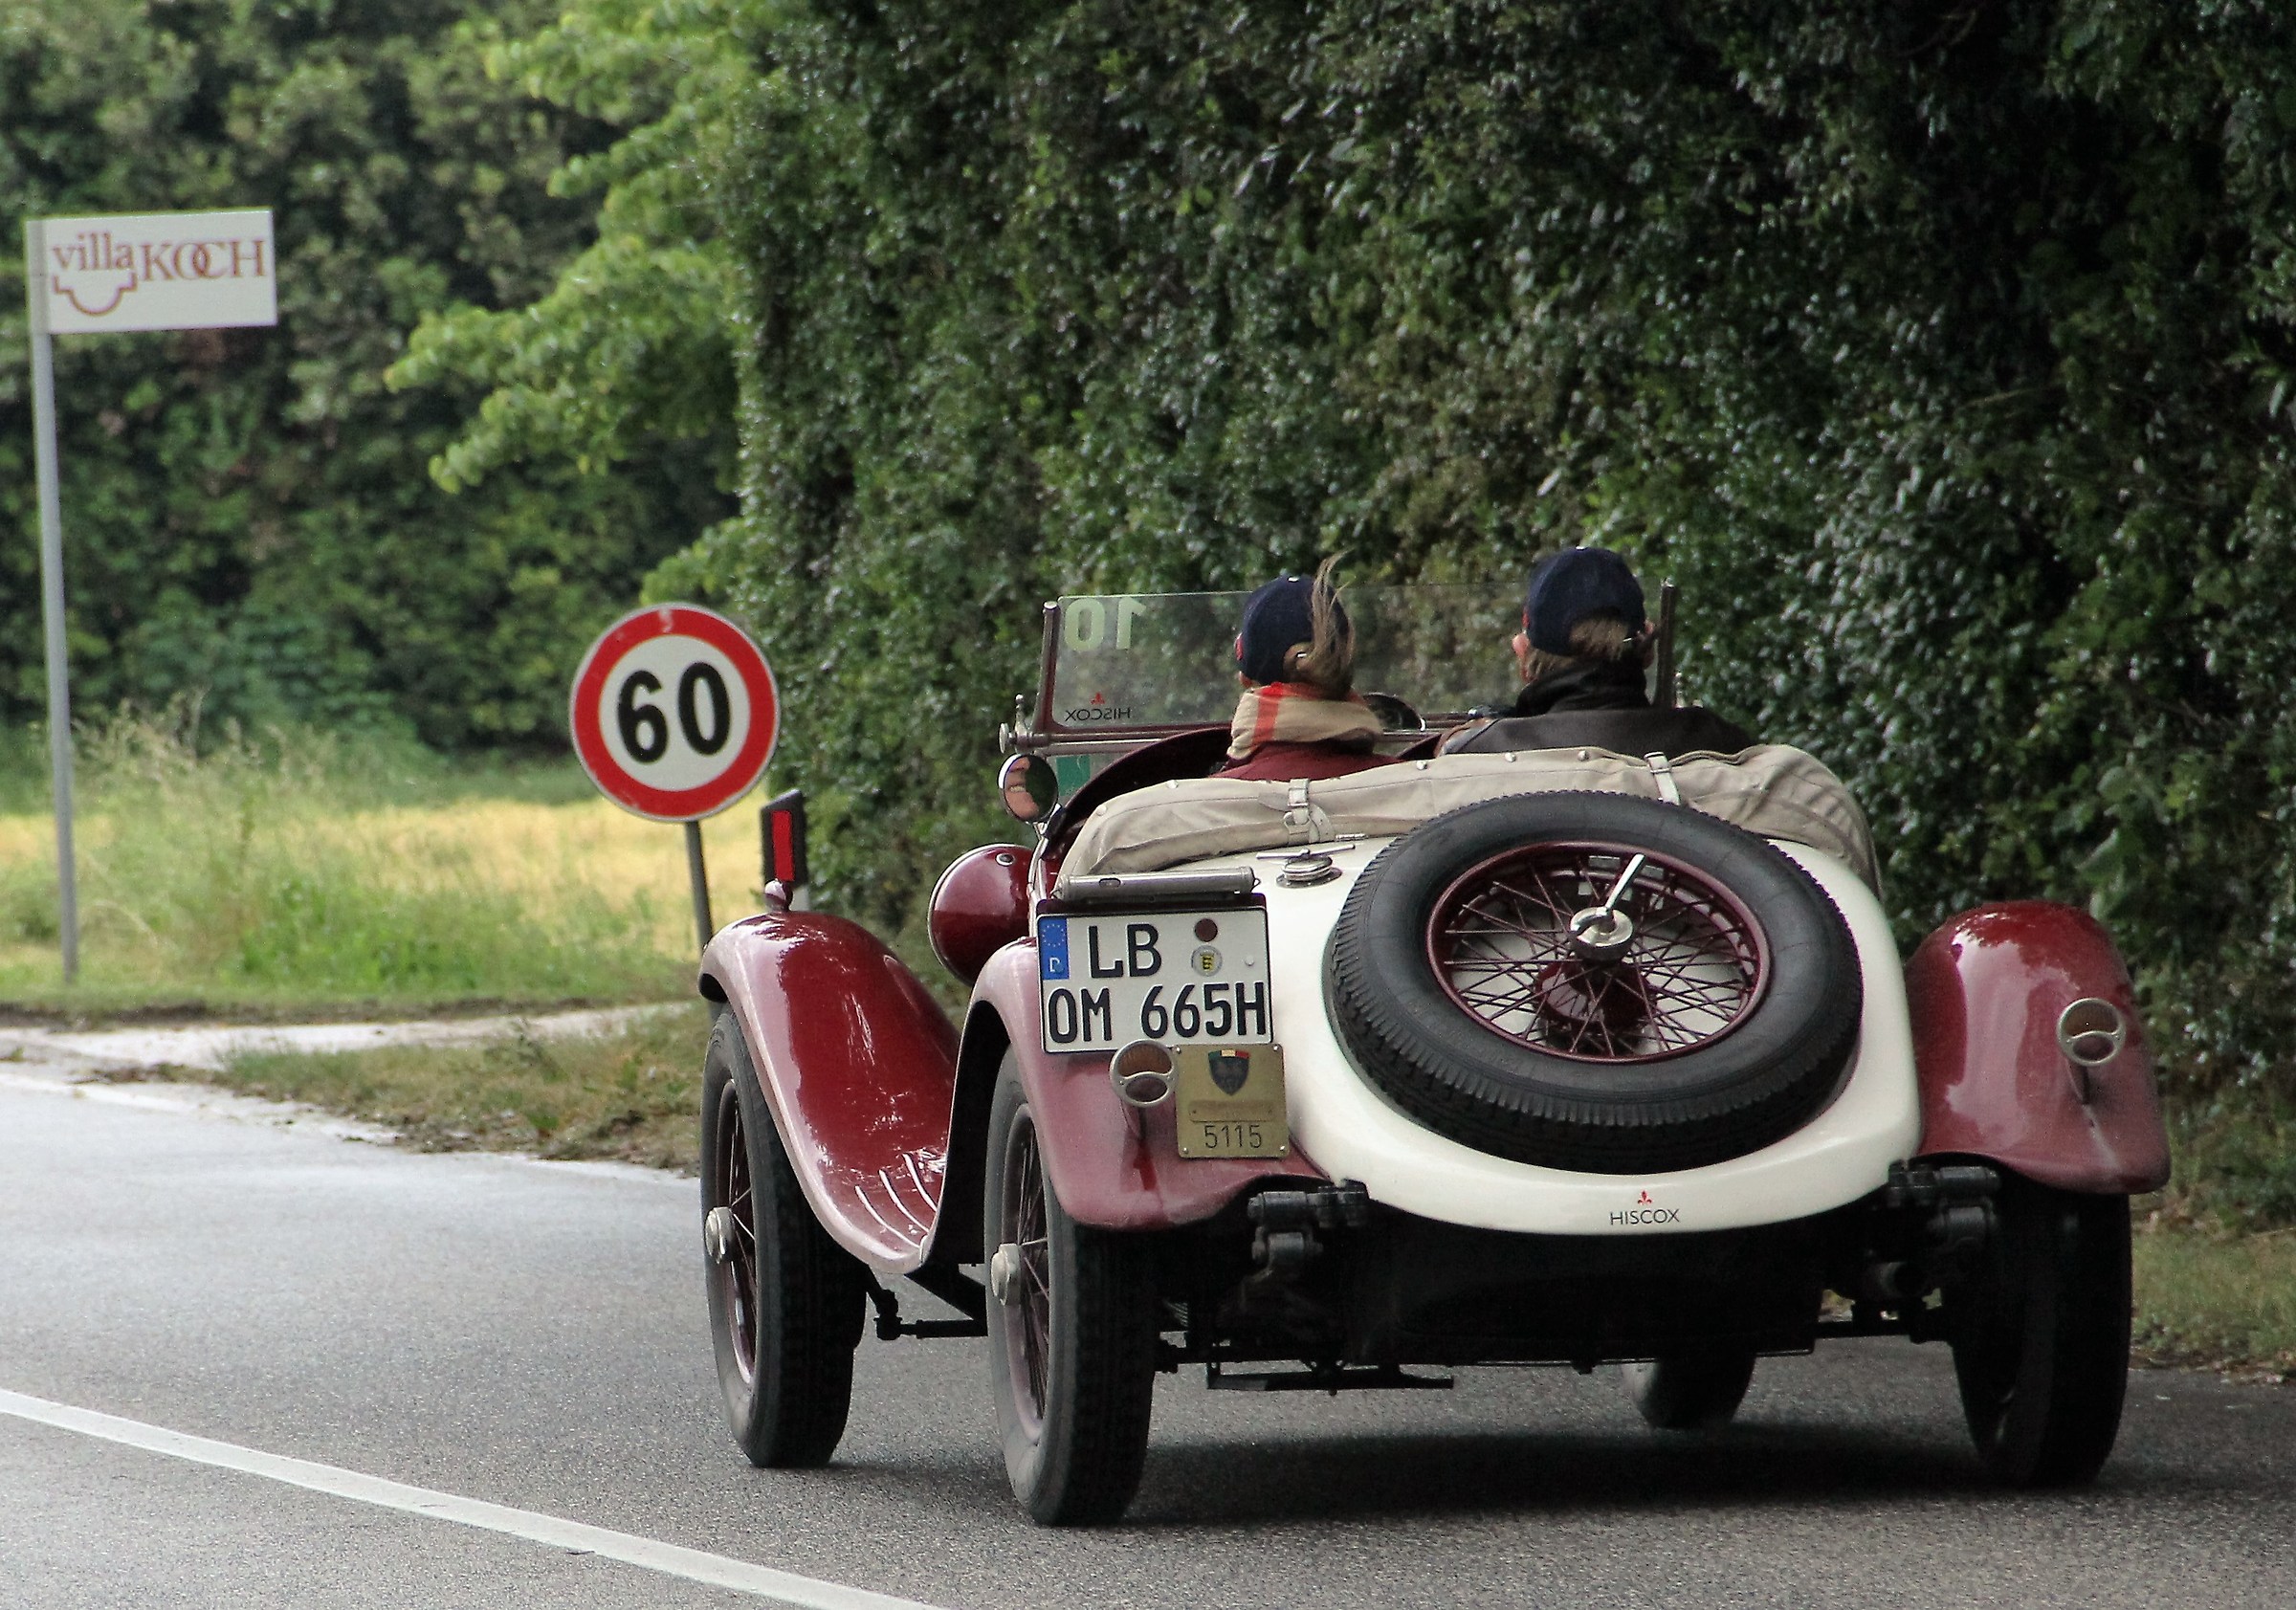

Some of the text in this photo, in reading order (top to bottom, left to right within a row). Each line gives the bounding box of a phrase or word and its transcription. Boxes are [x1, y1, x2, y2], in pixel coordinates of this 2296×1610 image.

[53, 232, 266, 281] villa KOCH
[618, 661, 731, 764] 60
[1049, 957, 1062, 973] D
[1088, 923, 1162, 979] LB
[1049, 981, 1268, 1044] OM 665H
[1203, 1124, 1262, 1149] 5115
[1609, 1208, 1680, 1225] HISCOX
